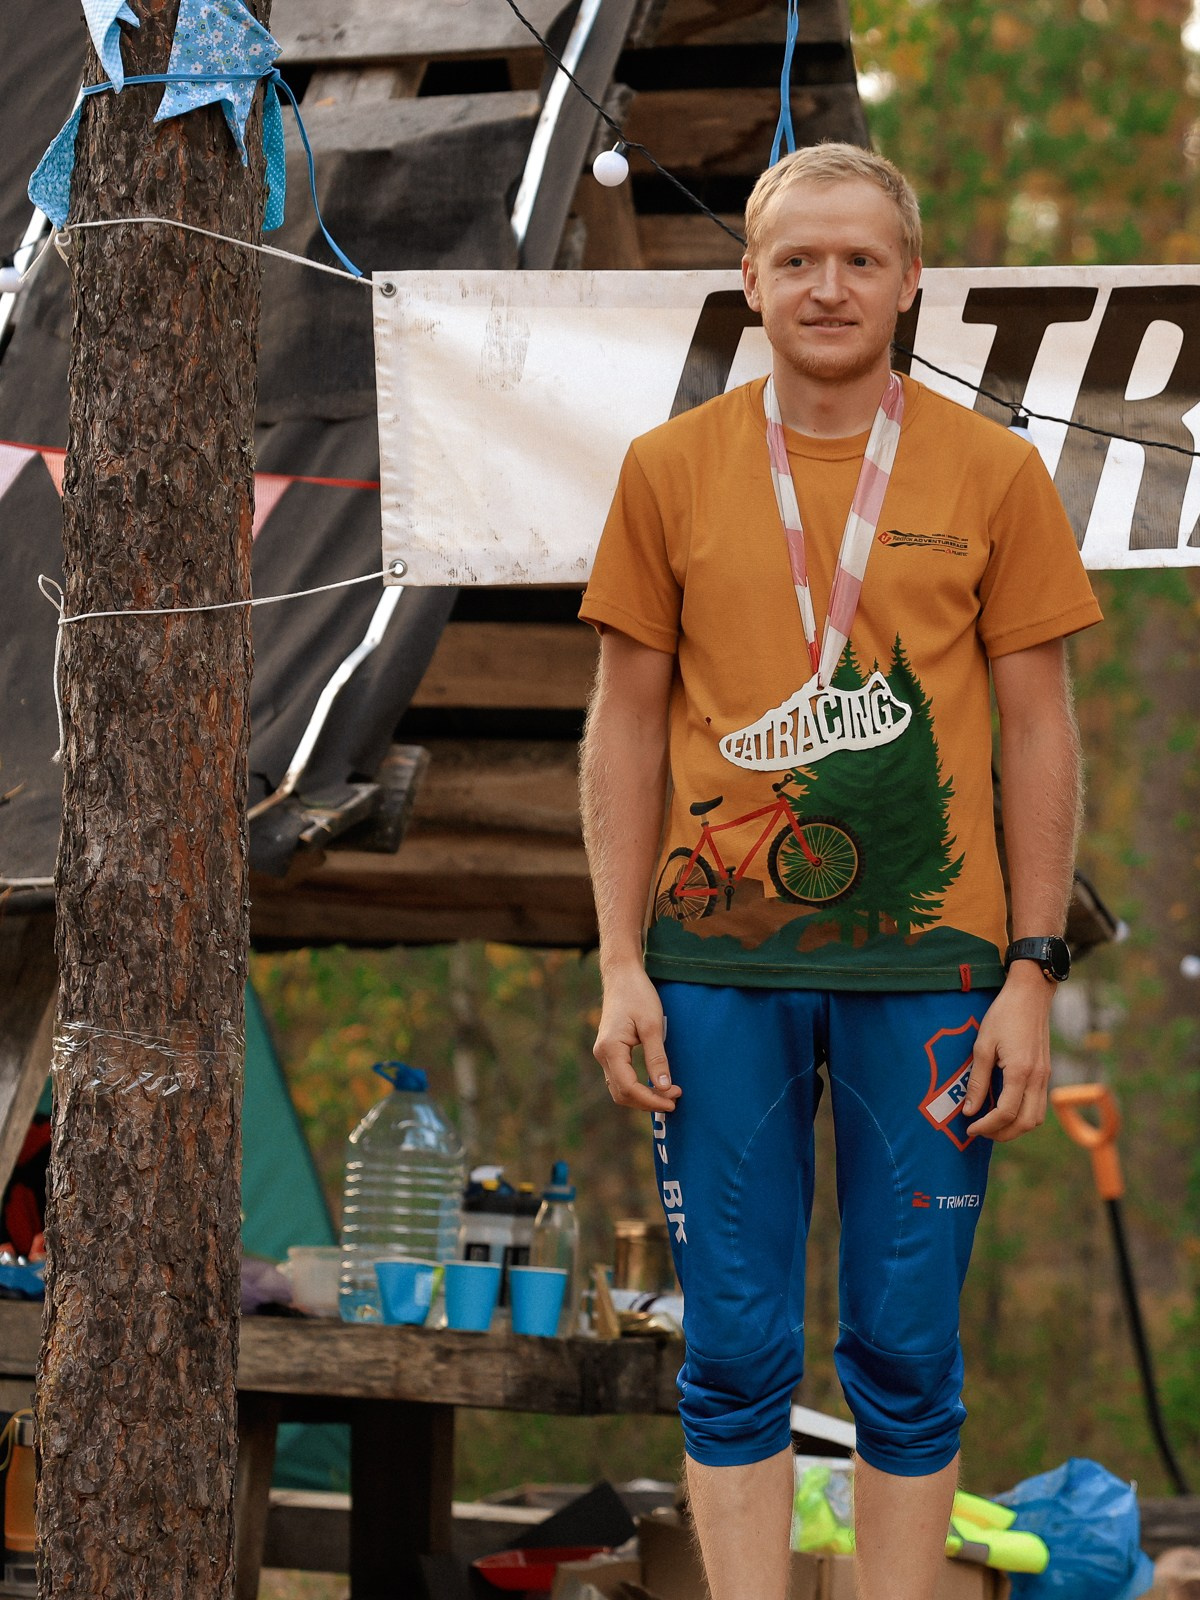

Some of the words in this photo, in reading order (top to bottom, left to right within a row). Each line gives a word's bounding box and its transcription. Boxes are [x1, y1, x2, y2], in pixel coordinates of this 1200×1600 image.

[729, 688, 894, 761] FATRACING
[663, 1180, 688, 1245] BK
[935, 1194, 980, 1209] TRIMTEX
